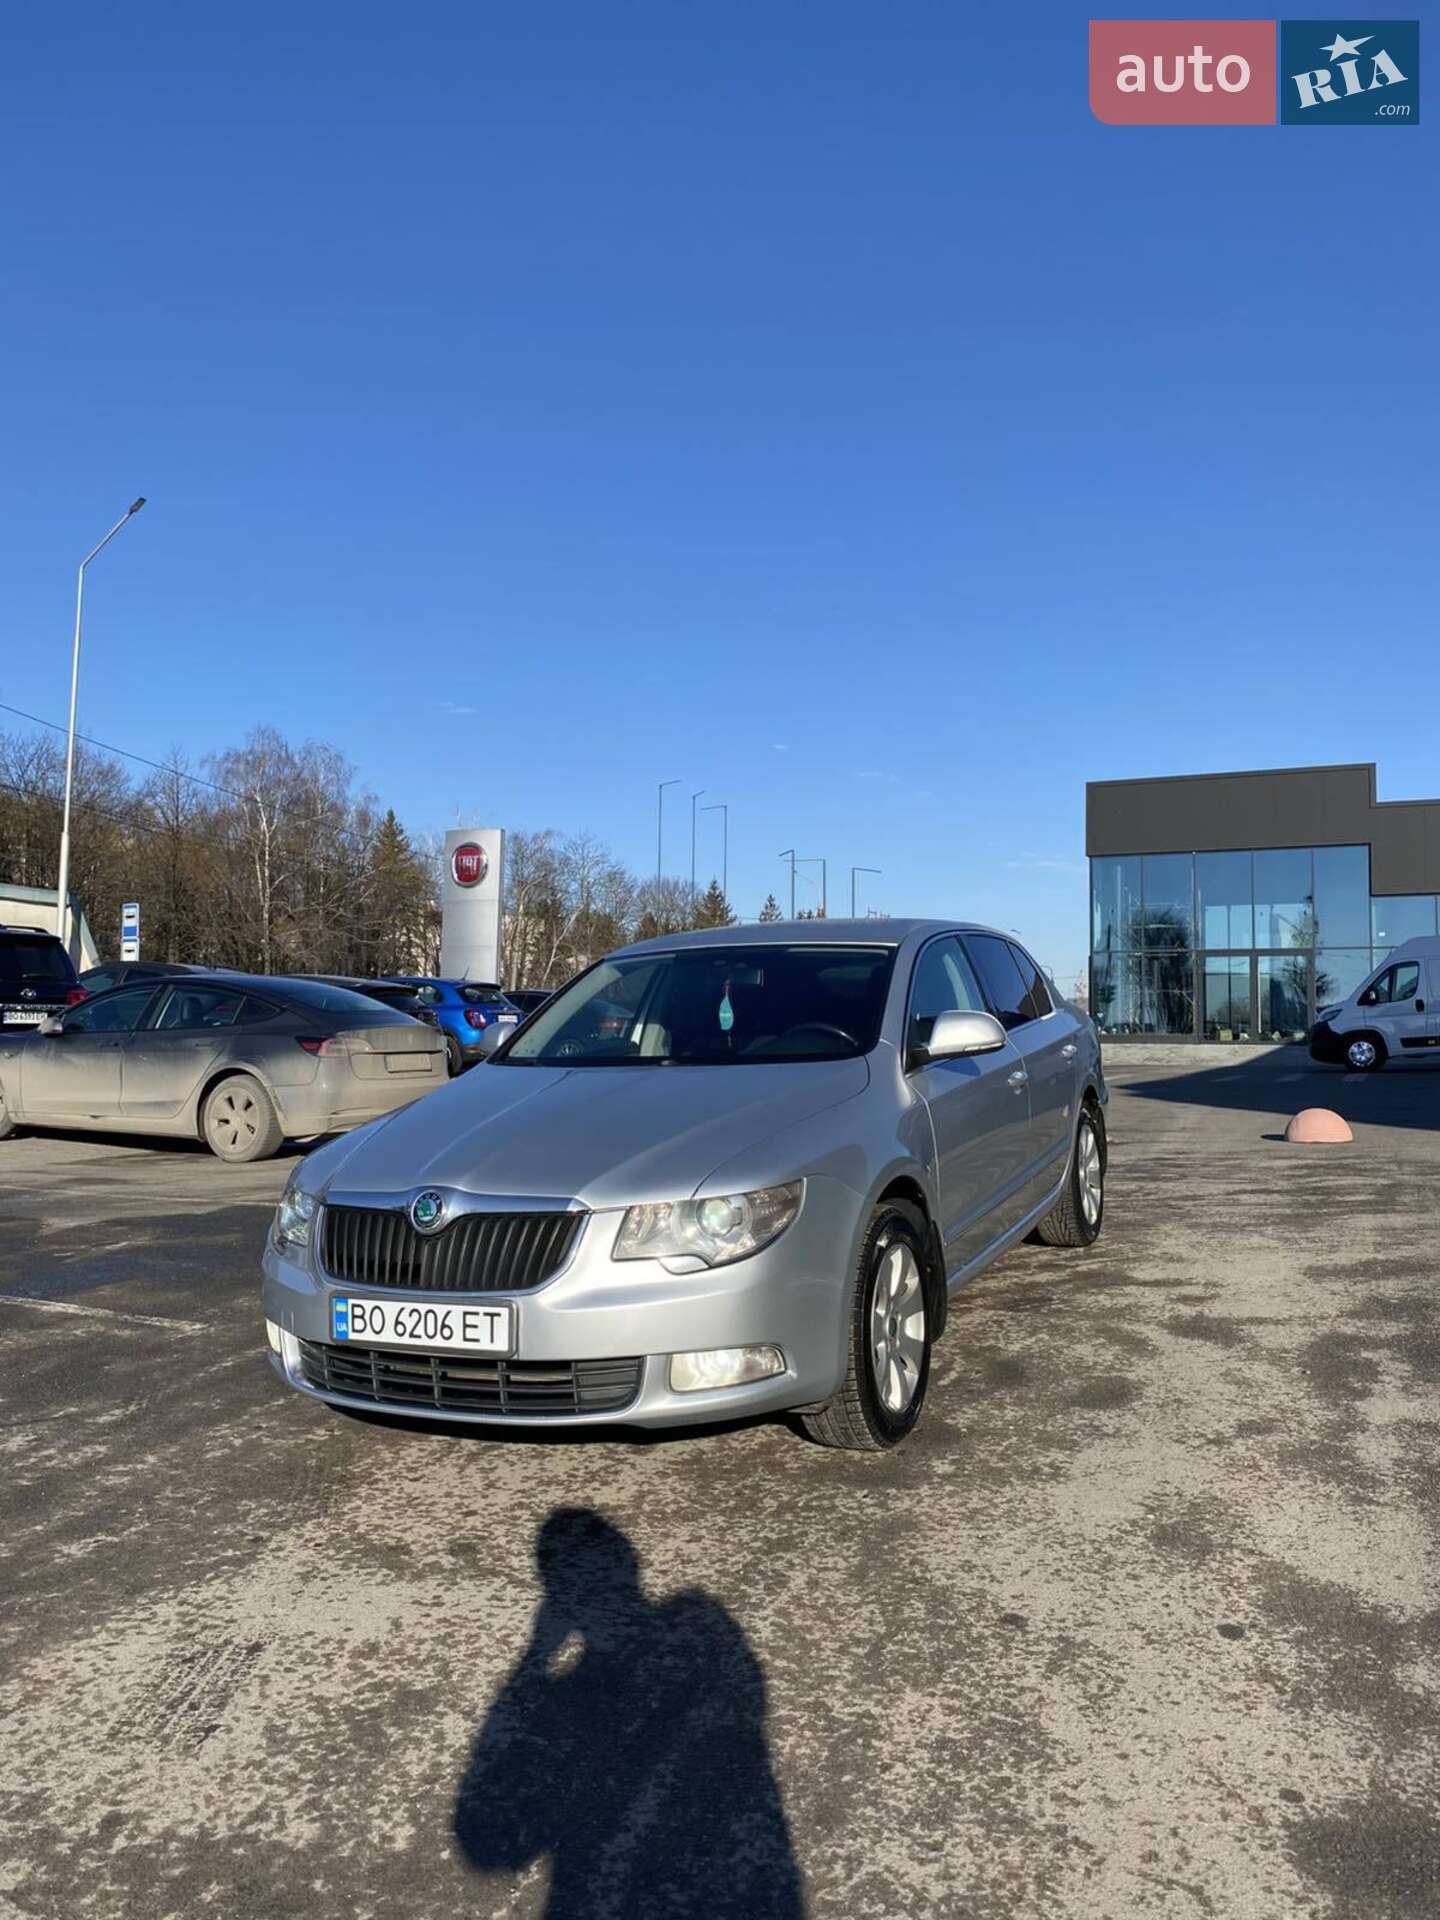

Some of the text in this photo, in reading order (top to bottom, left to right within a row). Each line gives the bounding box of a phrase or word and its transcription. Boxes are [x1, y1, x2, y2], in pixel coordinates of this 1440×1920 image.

[336, 1322, 348, 1332] UA
[351, 1303, 502, 1344] BO 6206 ET
